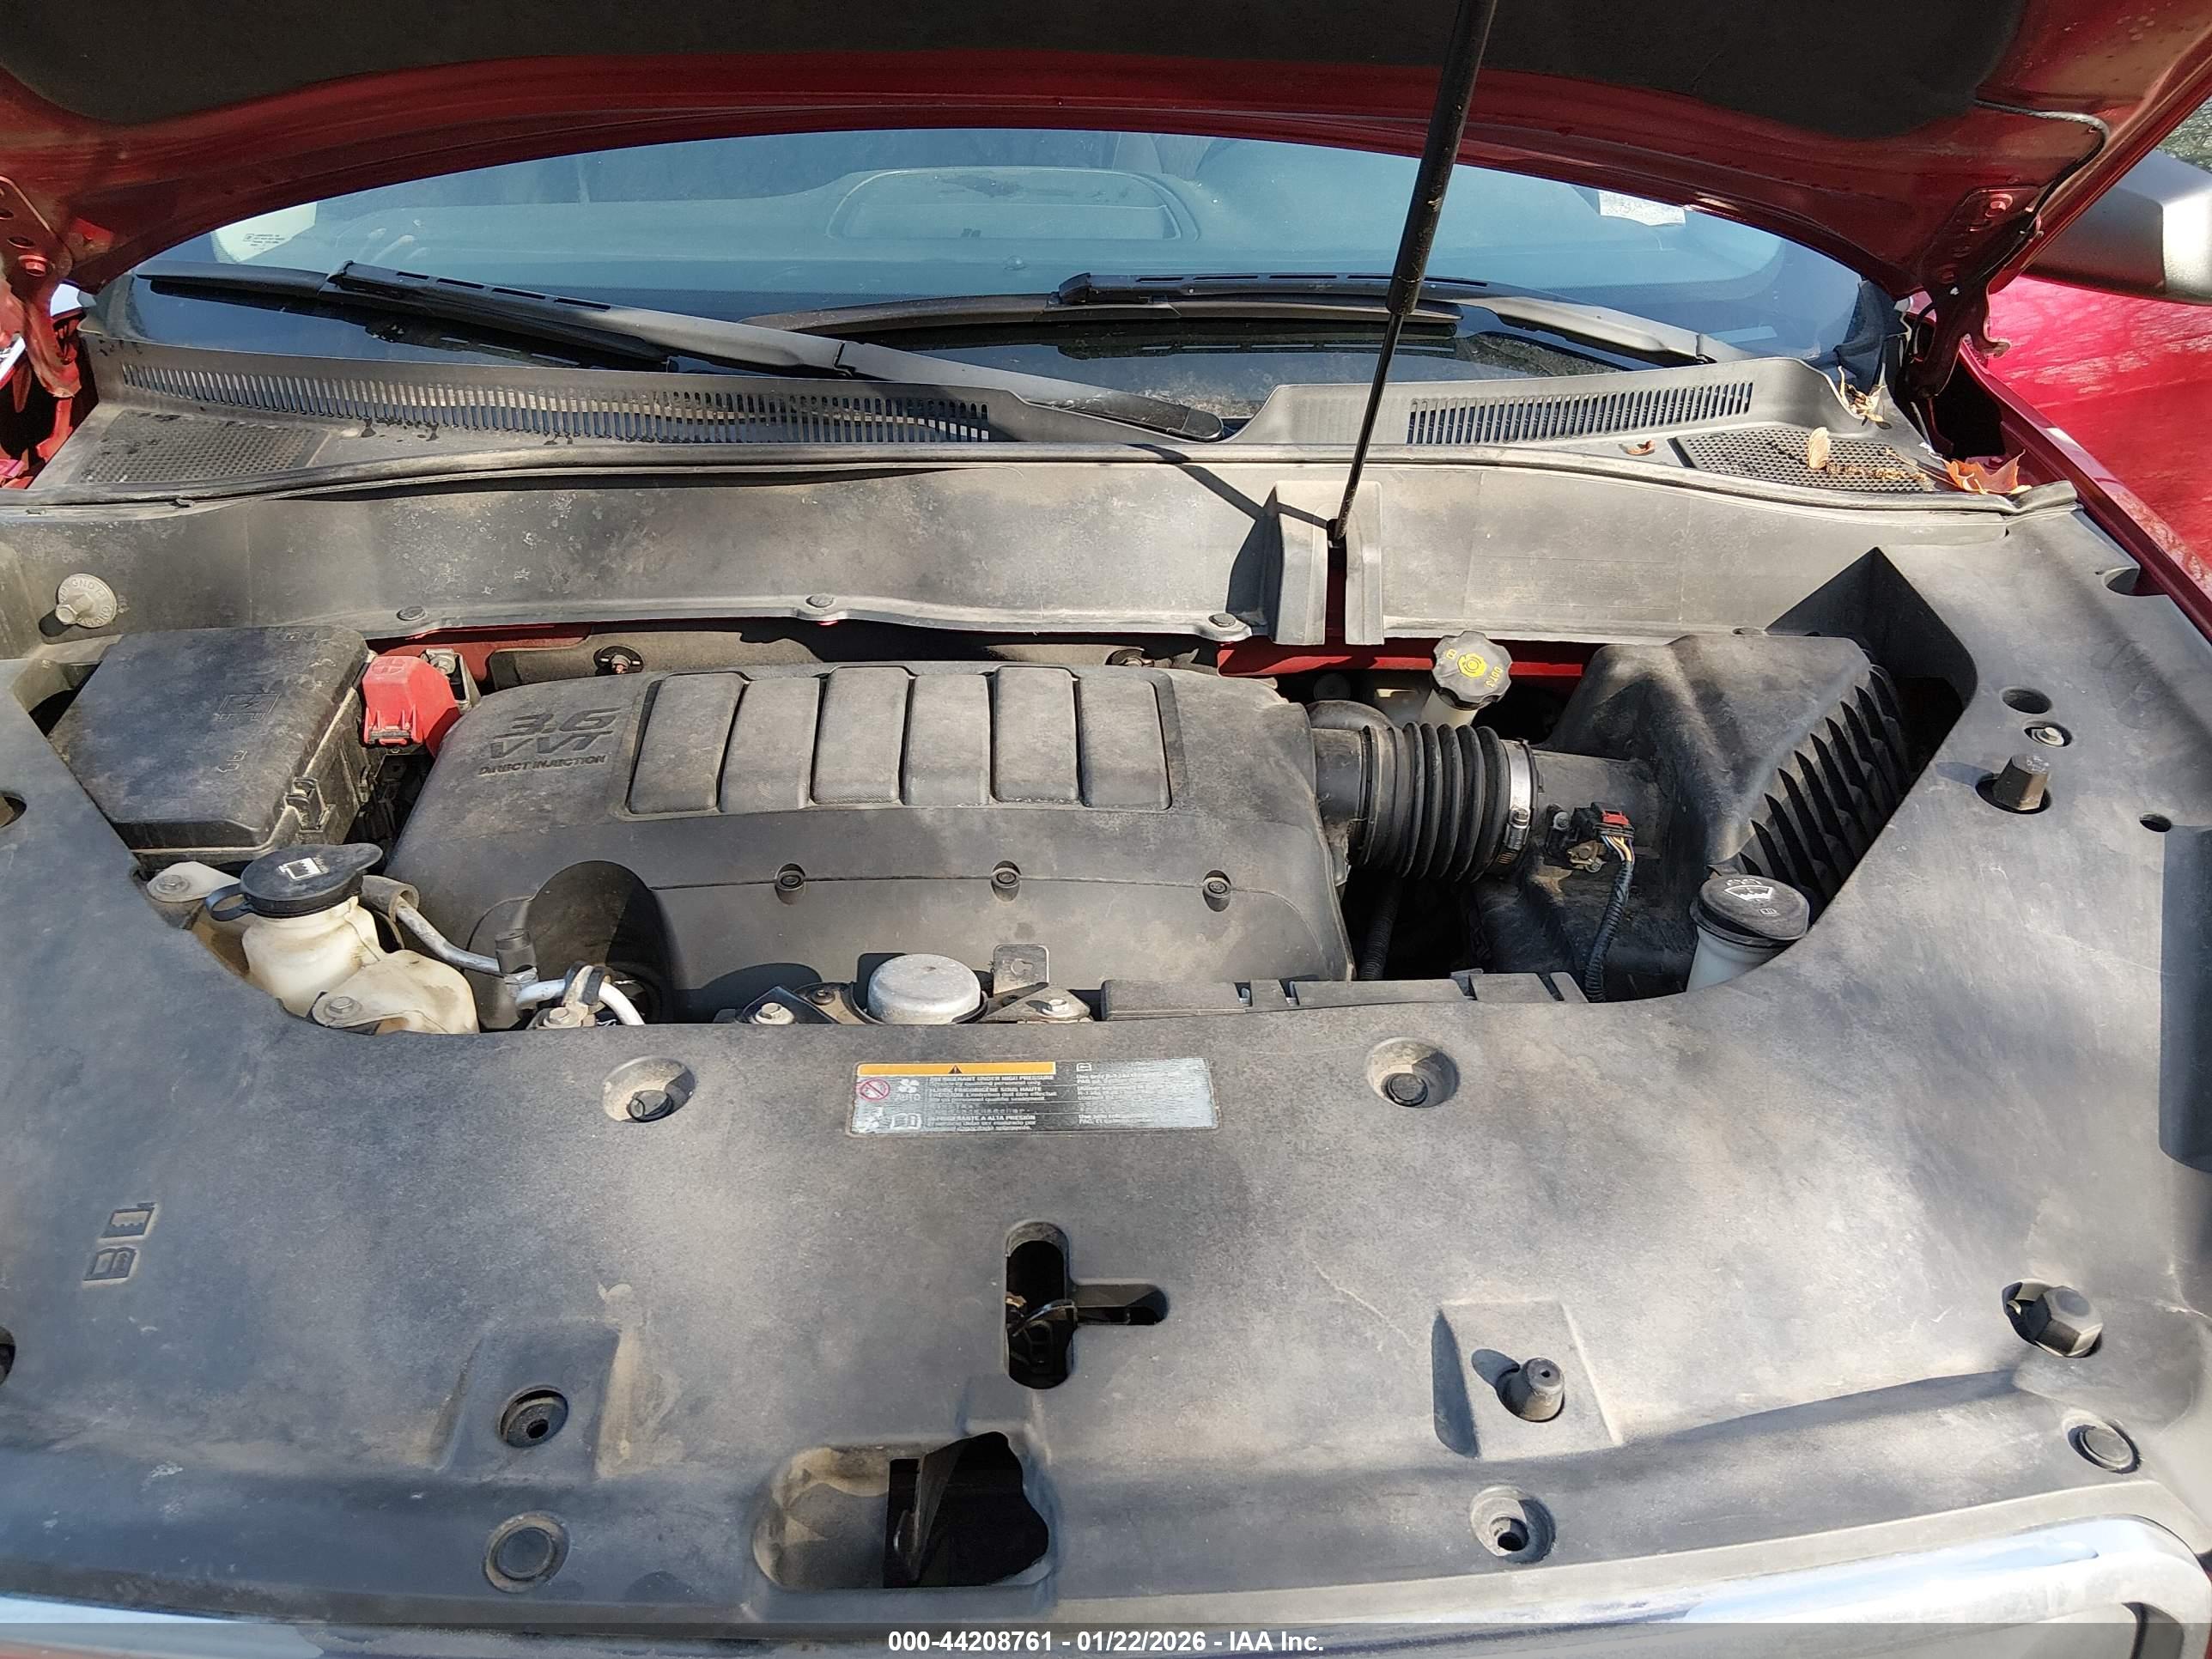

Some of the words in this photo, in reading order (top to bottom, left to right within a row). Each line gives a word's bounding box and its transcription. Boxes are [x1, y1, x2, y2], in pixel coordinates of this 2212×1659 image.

[71, 578, 94, 590] GND
[494, 706, 622, 739] 3.6
[489, 730, 613, 759] VVT
[478, 761, 533, 775] DIRECT
[532, 755, 606, 769] INJECTION
